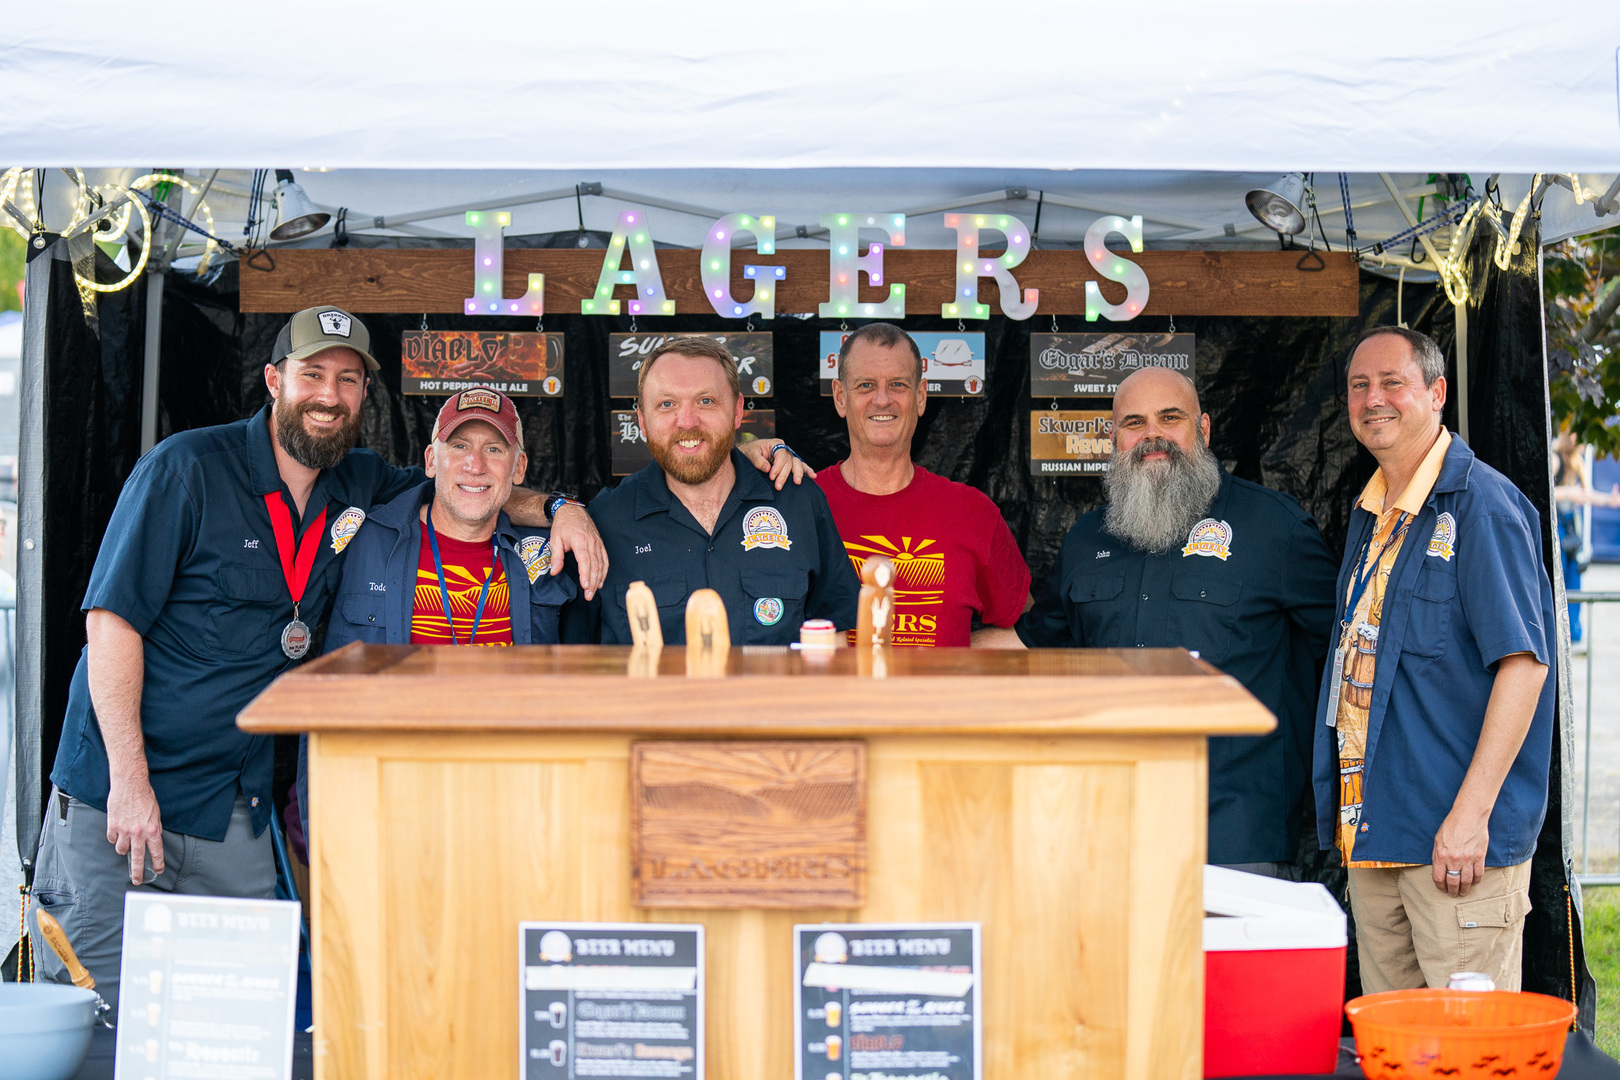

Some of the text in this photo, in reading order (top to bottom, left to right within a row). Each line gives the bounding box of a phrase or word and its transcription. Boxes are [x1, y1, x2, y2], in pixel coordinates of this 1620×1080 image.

[464, 210, 1150, 322] LAGERS
[1039, 348, 1190, 372] Edgar's Dream
[420, 381, 441, 391] HOT
[508, 383, 529, 392] ALE
[1073, 383, 1105, 393] SWEET
[617, 413, 632, 421] The
[1038, 416, 1113, 434] Skwerl's
[1065, 435, 1113, 455] Reve
[1041, 462, 1110, 472] RUSSIAN IMPE
[243, 539, 259, 549] Jeff
[748, 533, 784, 543] LAGERS
[634, 543, 652, 555] Joel
[1190, 542, 1225, 553] LAGERS
[177, 911, 271, 932] BEER MENU
[575, 938, 675, 957] BEER MENU
[850, 938, 951, 957] BEER MENU
